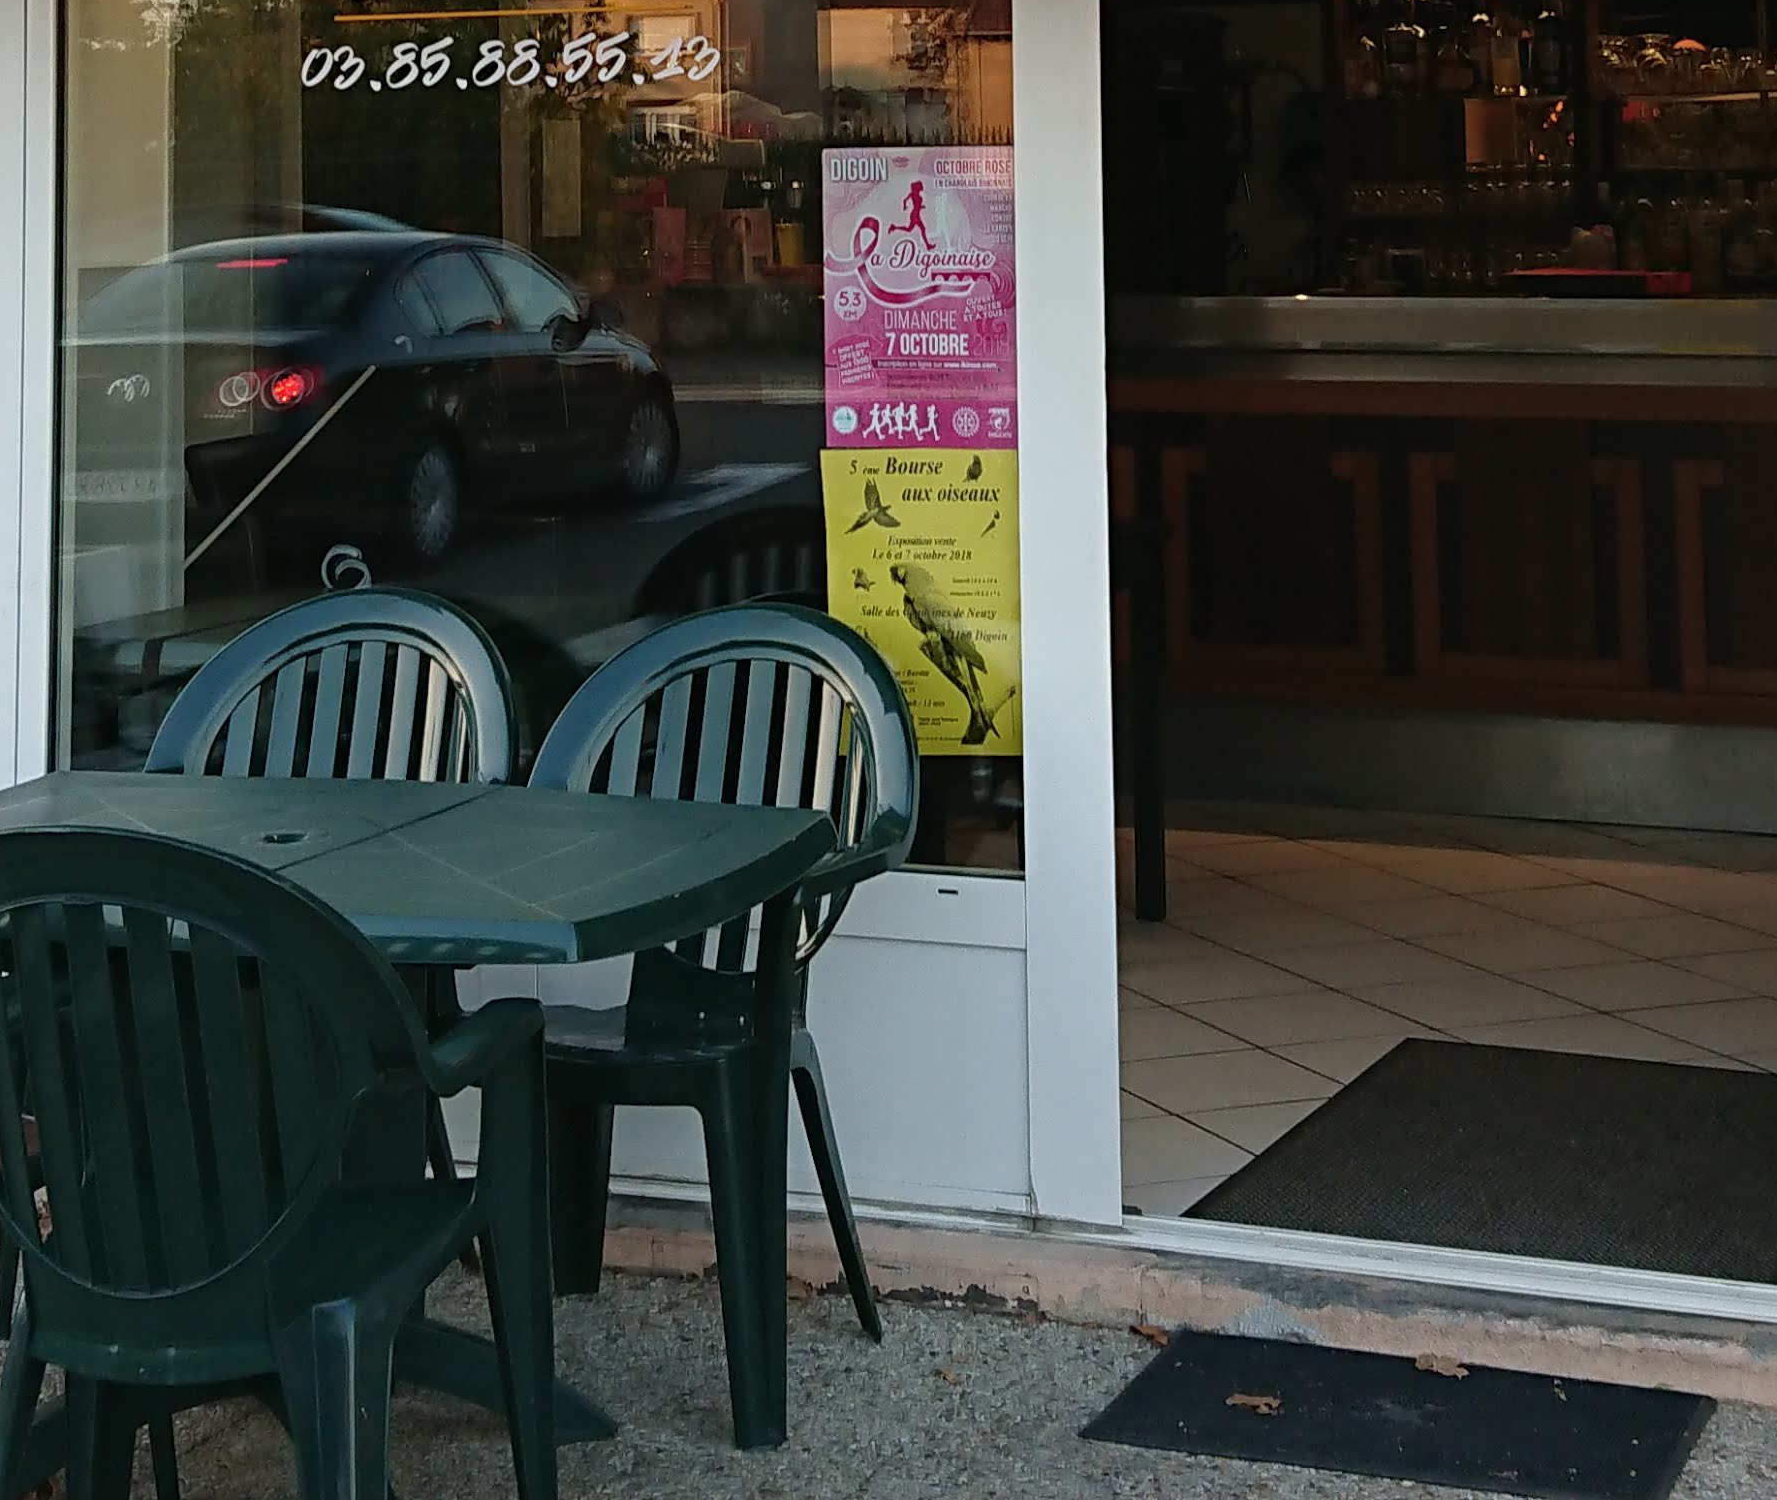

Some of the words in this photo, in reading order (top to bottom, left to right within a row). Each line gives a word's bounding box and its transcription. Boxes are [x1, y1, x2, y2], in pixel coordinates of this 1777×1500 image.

[300, 30, 721, 92] 03.85.88.55.13
[830, 157, 889, 182] DIGOIN
[935, 159, 983, 175] OCTOBRE
[985, 158, 1012, 174] ROSE
[888, 238, 995, 278] Digoinaise
[884, 309, 957, 330] DIMANCHE
[885, 332, 896, 356] 7
[899, 332, 970, 357] OCTOBRE
[849, 459, 858, 476] 5
[884, 456, 944, 476] Bourse
[901, 487, 933, 503] aux
[937, 483, 1001, 503] oiseaux
[934, 536, 958, 547] vente
[872, 549, 885, 560] Le
[886, 549, 893, 560] 6
[913, 549, 948, 561] octobre
[950, 549, 973, 561] 2018
